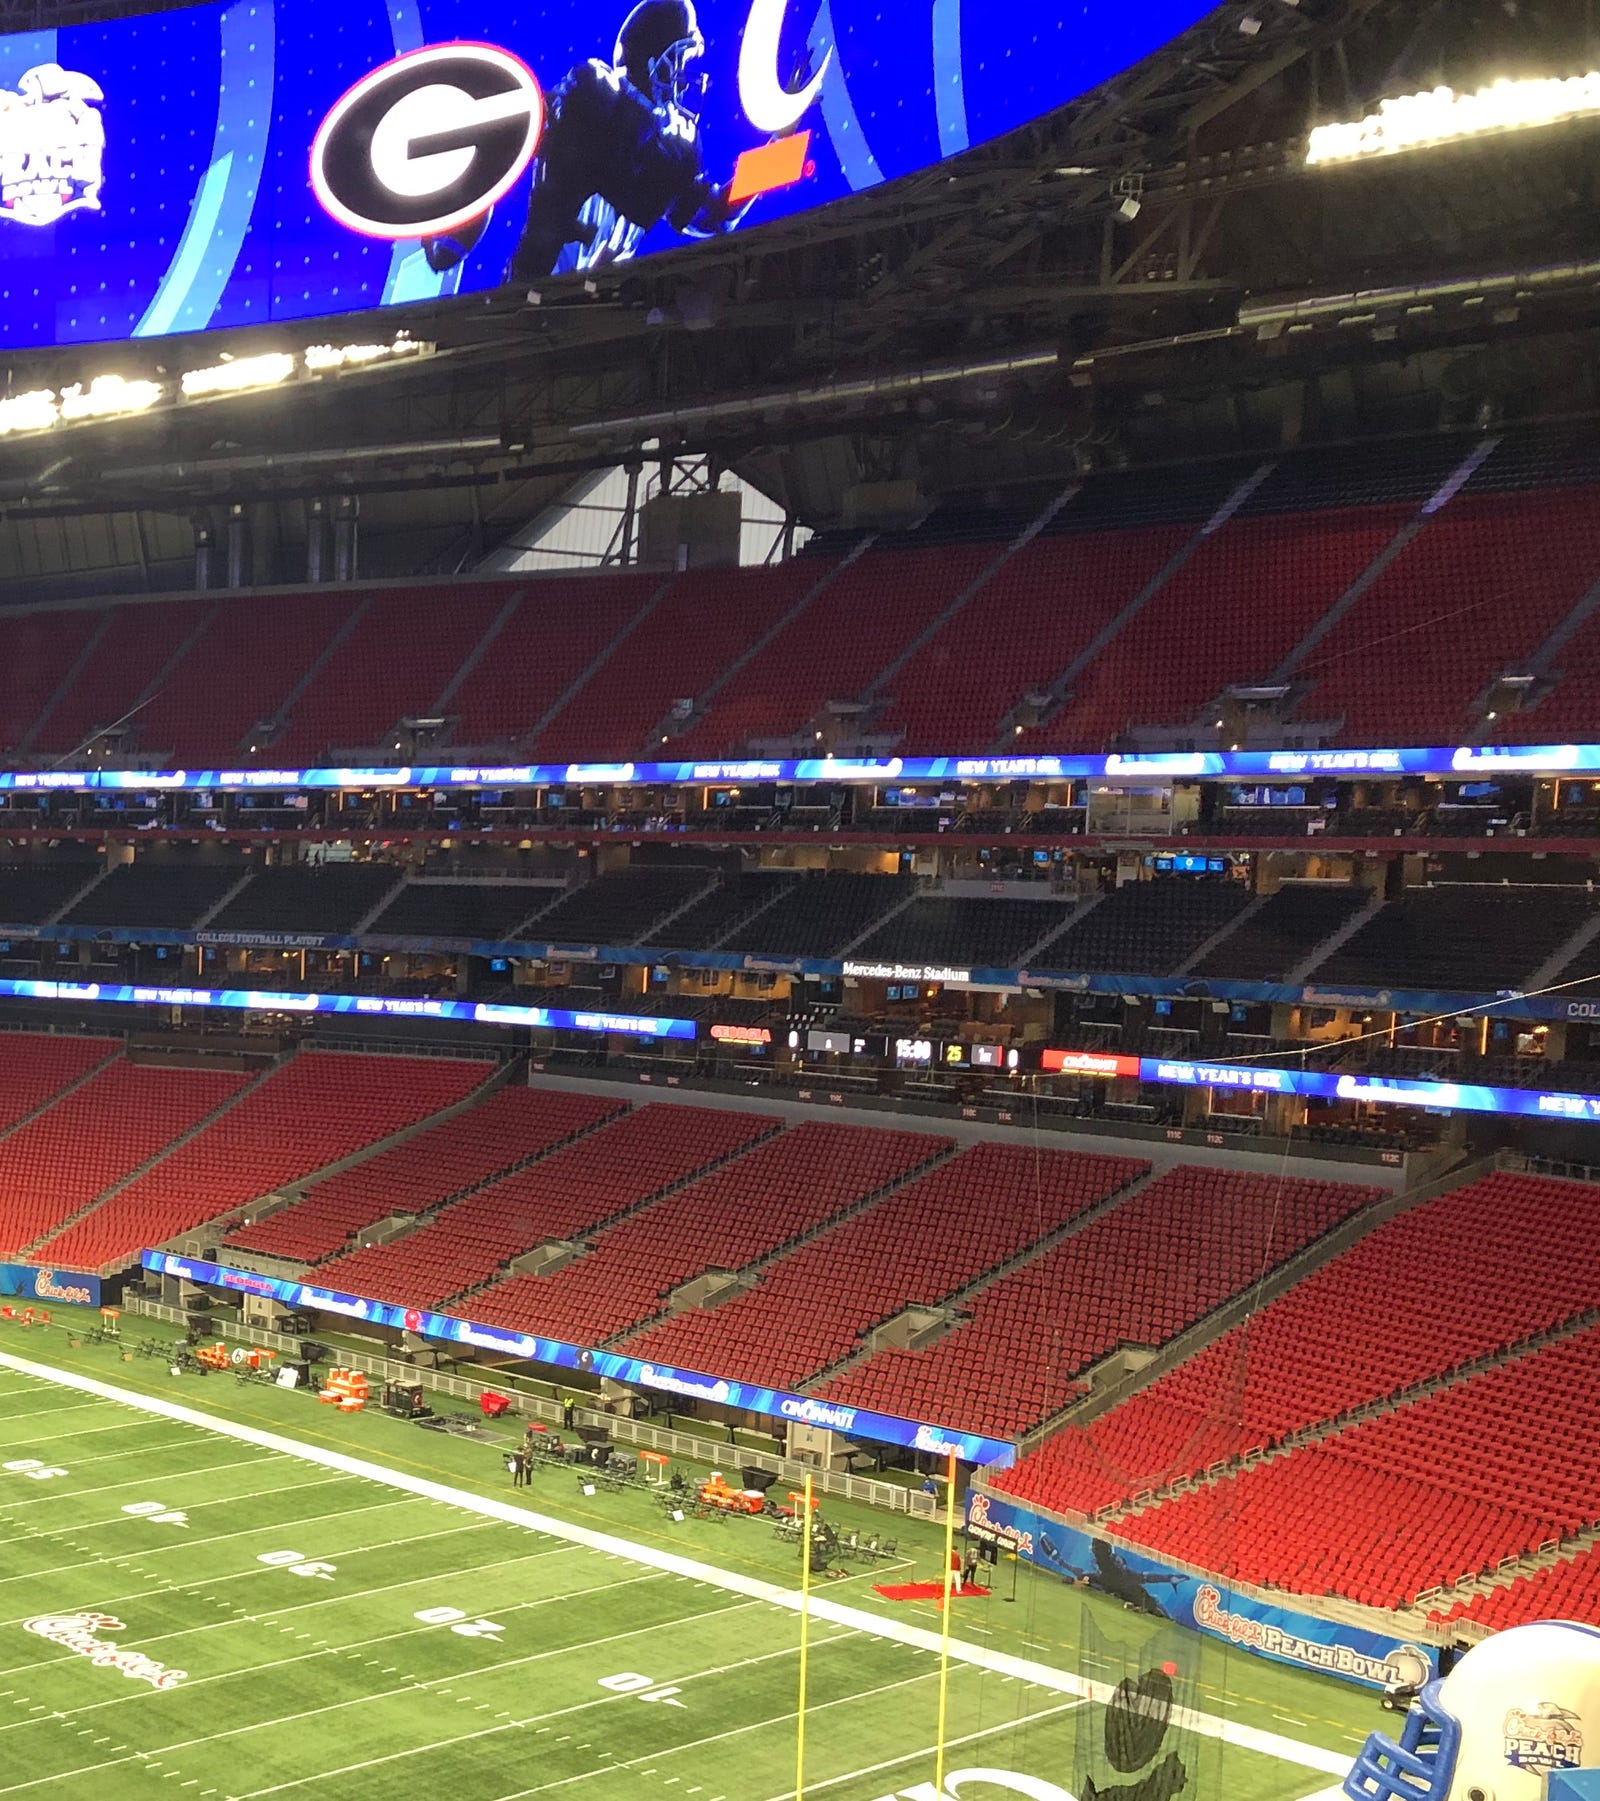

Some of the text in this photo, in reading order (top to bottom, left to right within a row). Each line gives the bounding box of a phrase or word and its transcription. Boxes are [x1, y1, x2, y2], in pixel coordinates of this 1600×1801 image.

[1269, 755, 1308, 769] NEW
[196, 933, 236, 943] COLLEGE
[236, 934, 283, 945] FOOTBALL
[843, 962, 969, 982] Mercedes-Benz Stadium
[710, 1025, 771, 1042] GEORGIA
[896, 1039, 931, 1059] 15:00
[947, 1045, 962, 1062] 25
[1158, 1064, 1282, 1087] NEW YEAR'S SIX
[1539, 1096, 1586, 1114] NEW
[223, 1273, 274, 1292] GEORGIA
[781, 1399, 855, 1429] CINCINNATI
[1193, 1585, 1402, 1684] Chick-fil-A PEACH BOWL
[1504, 1737, 1581, 1766] PEACH
[1518, 1755, 1564, 1767] BOWL
